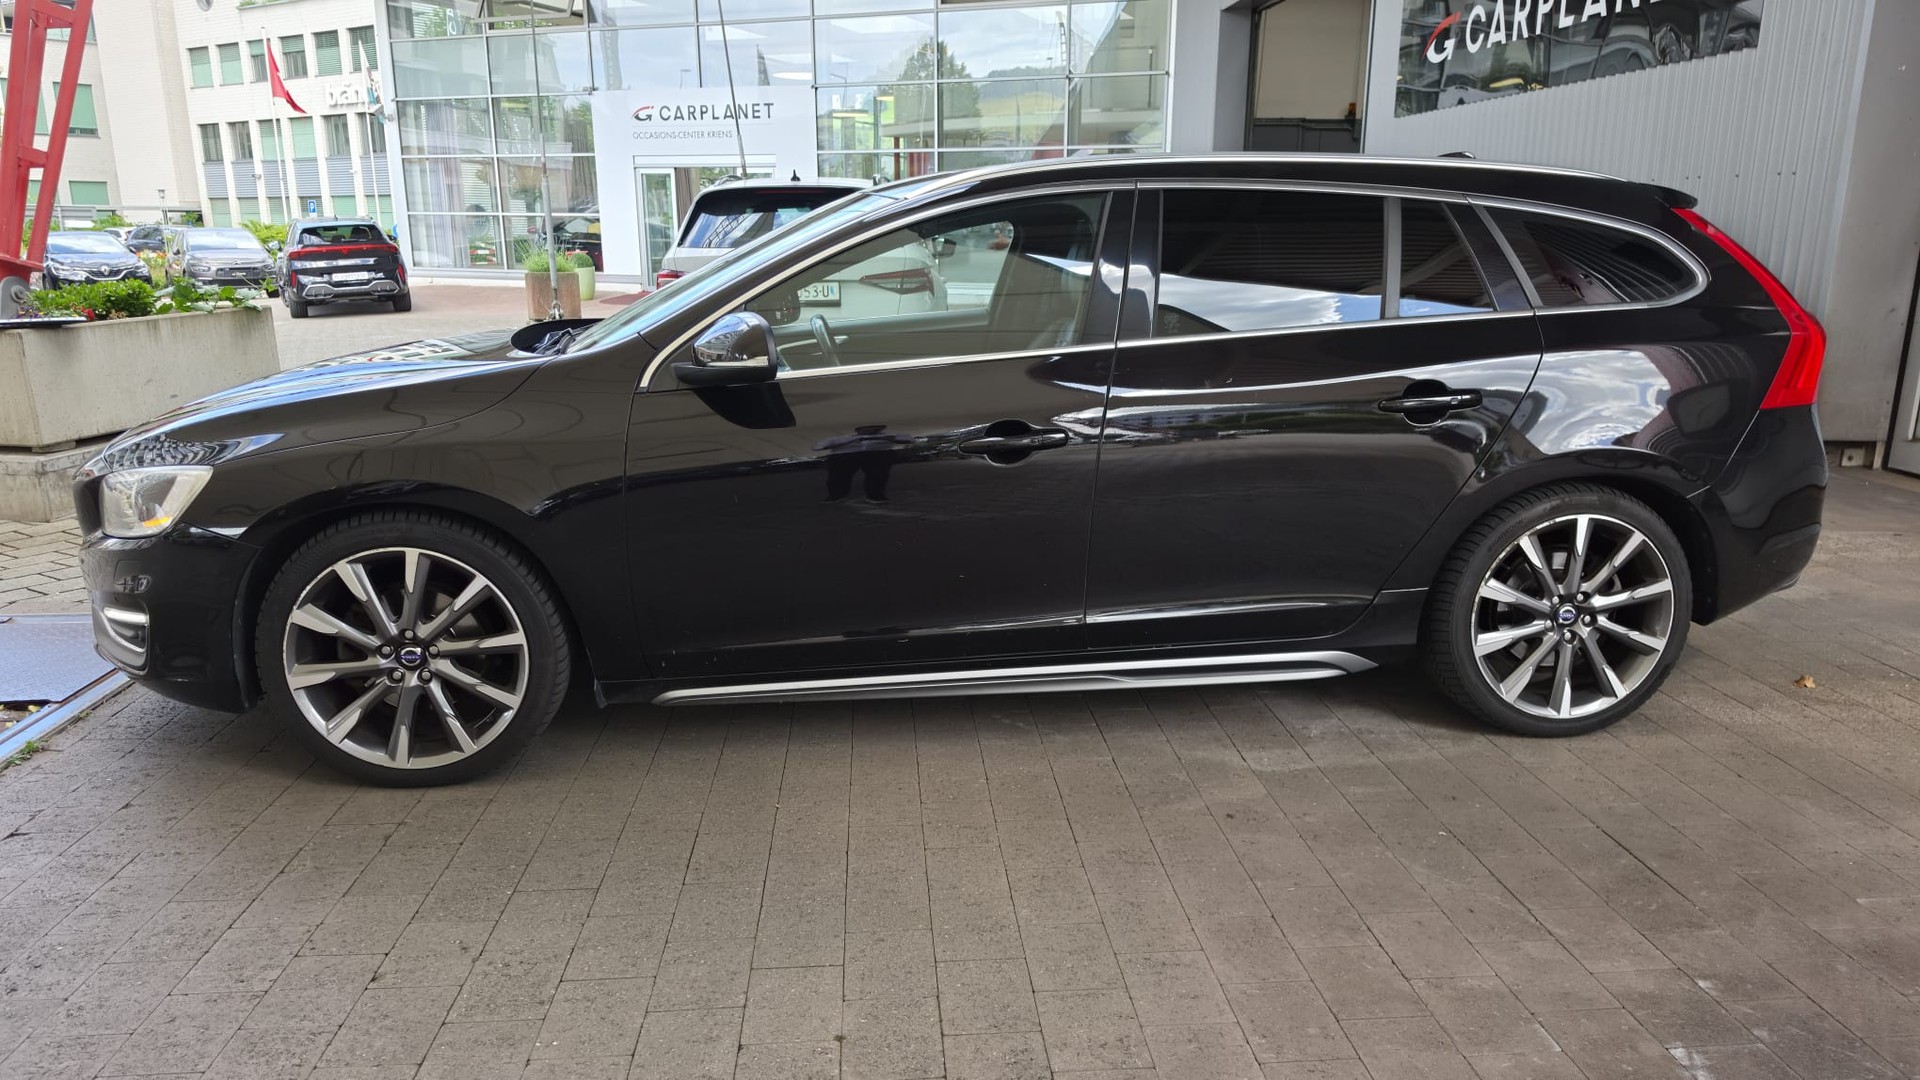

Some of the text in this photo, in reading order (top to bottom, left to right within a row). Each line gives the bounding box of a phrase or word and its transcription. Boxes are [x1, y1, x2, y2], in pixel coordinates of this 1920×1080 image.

[1465, 0, 1658, 52] CARPL
[659, 103, 774, 121] CARPLANET
[707, 130, 733, 139] KRIENS
